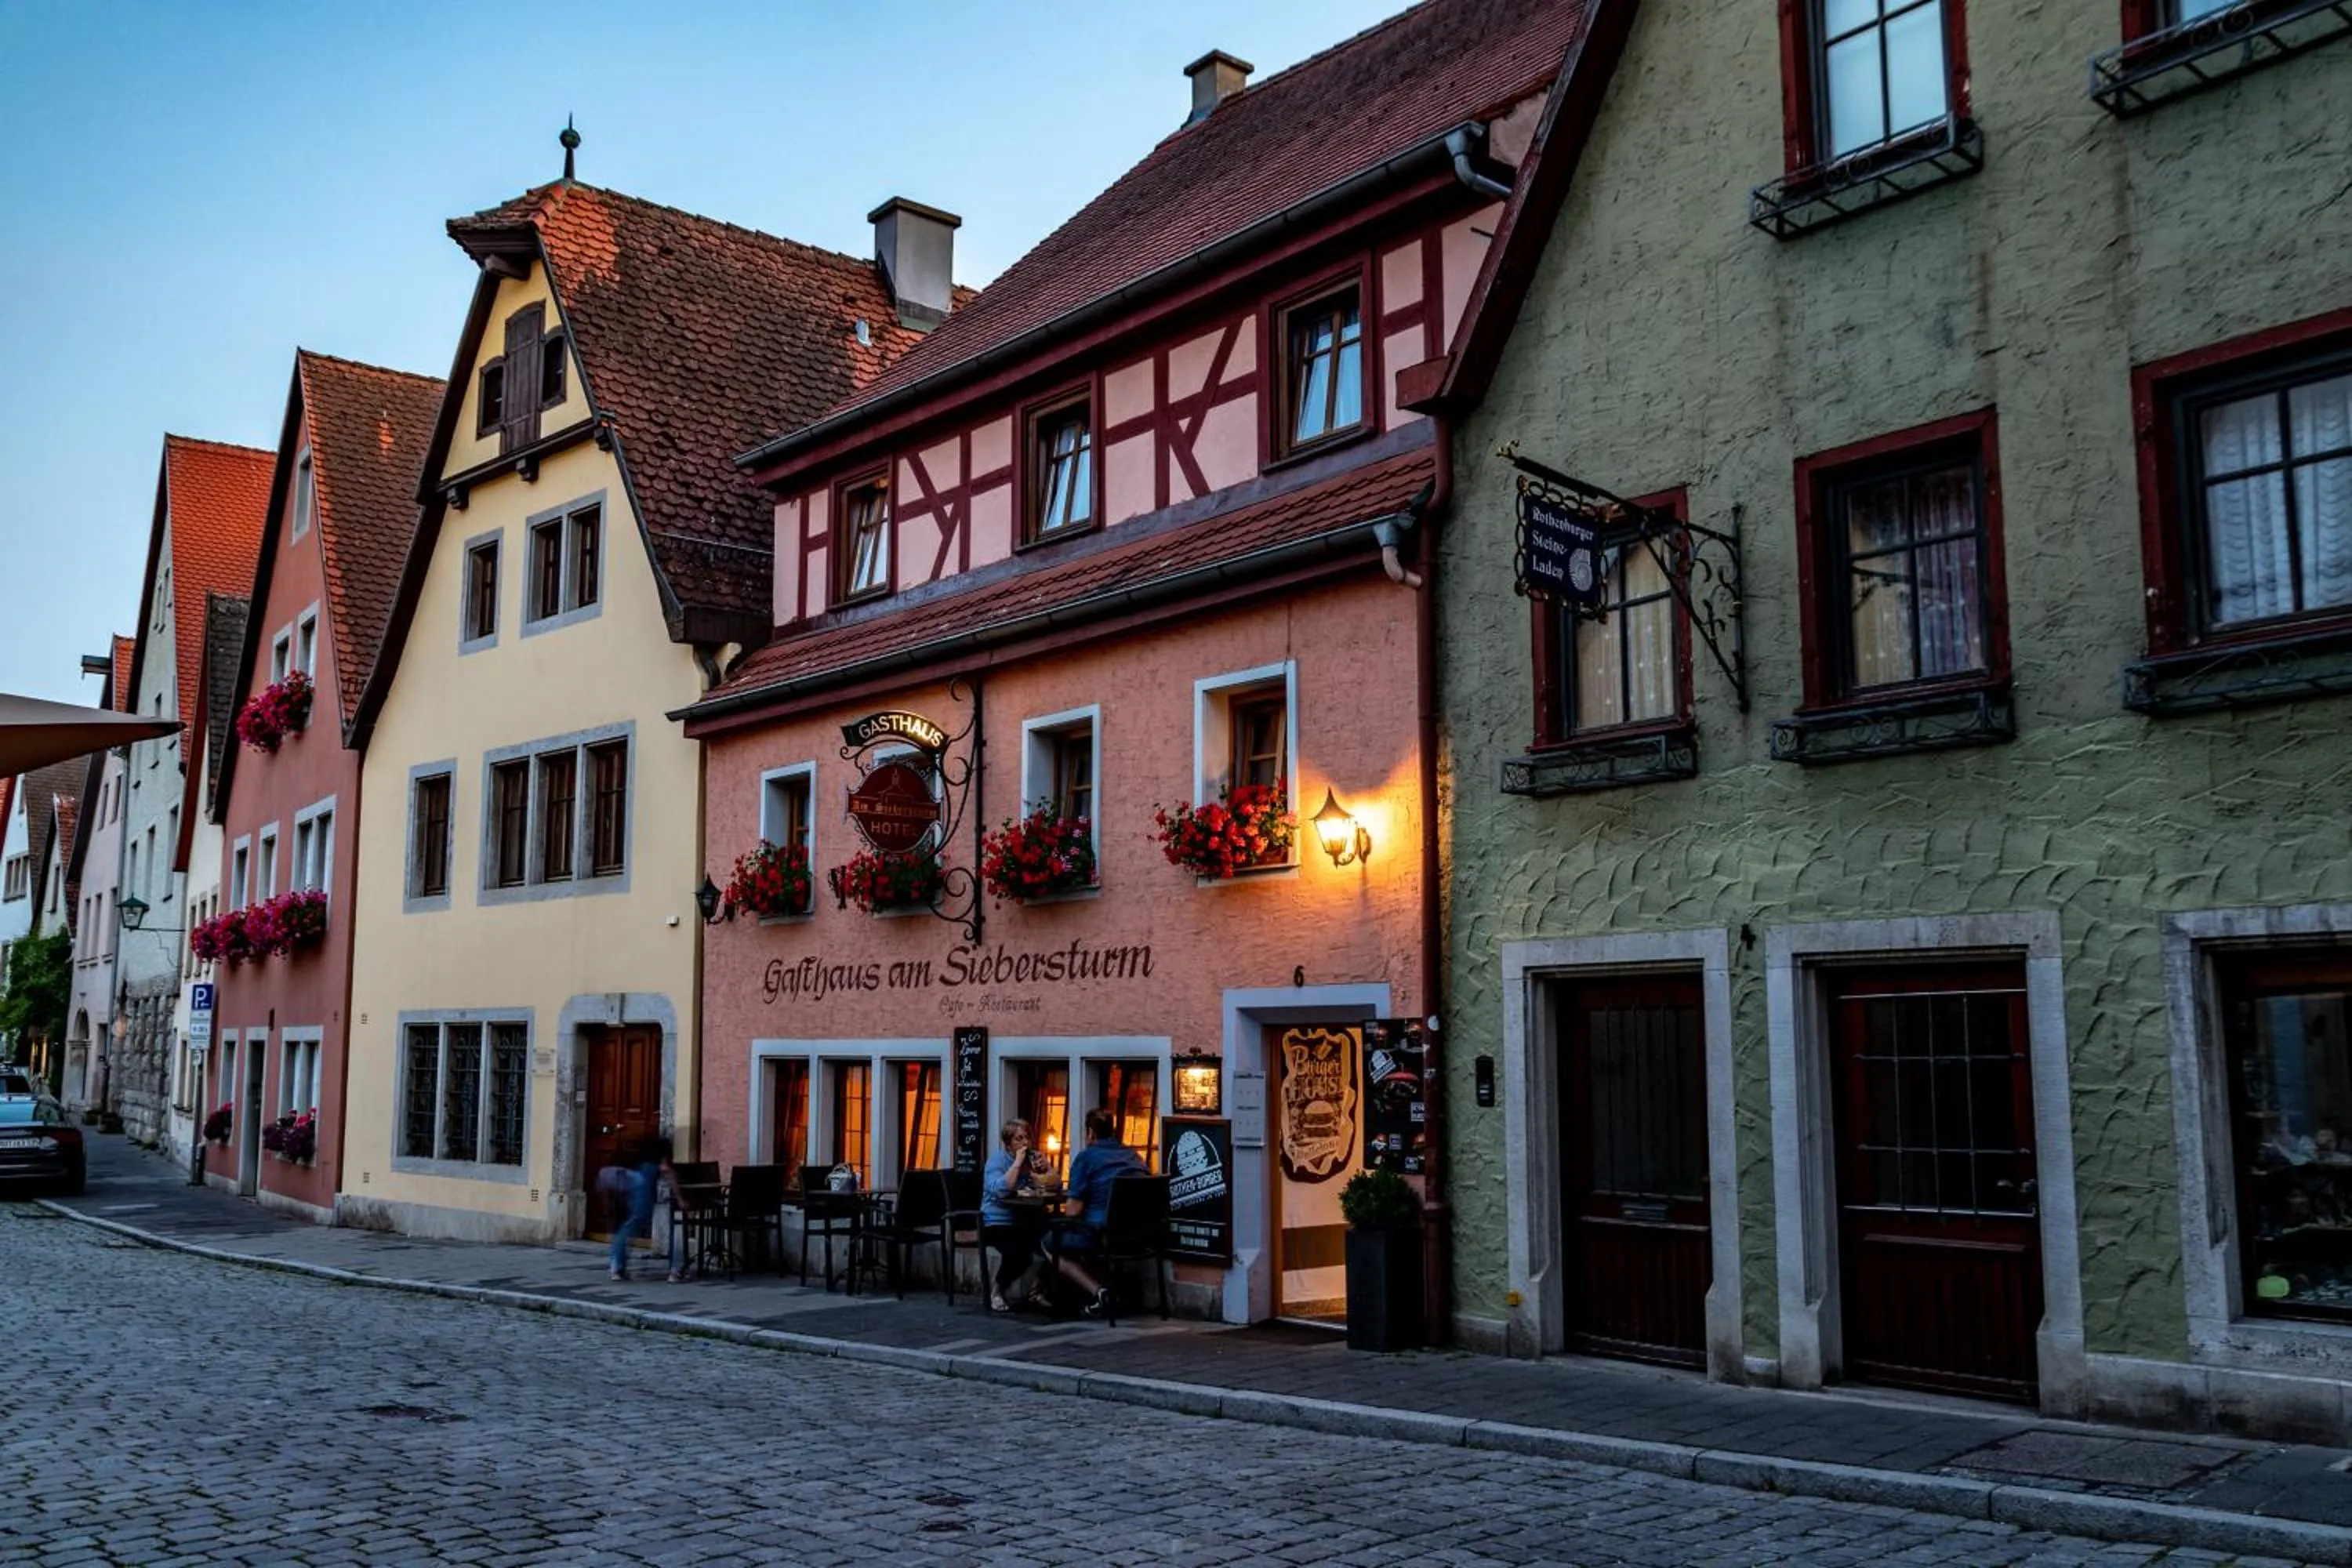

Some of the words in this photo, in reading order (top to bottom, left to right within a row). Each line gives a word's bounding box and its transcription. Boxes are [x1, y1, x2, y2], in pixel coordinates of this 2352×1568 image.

[1532, 554, 1565, 581] Laden
[858, 714, 944, 748] GASTHAUS
[870, 821, 920, 837] HOTEL
[888, 960, 932, 989] am
[938, 938, 1155, 987] Siebersturm
[1294, 964, 1305, 987] 6
[194, 987, 208, 1010] P
